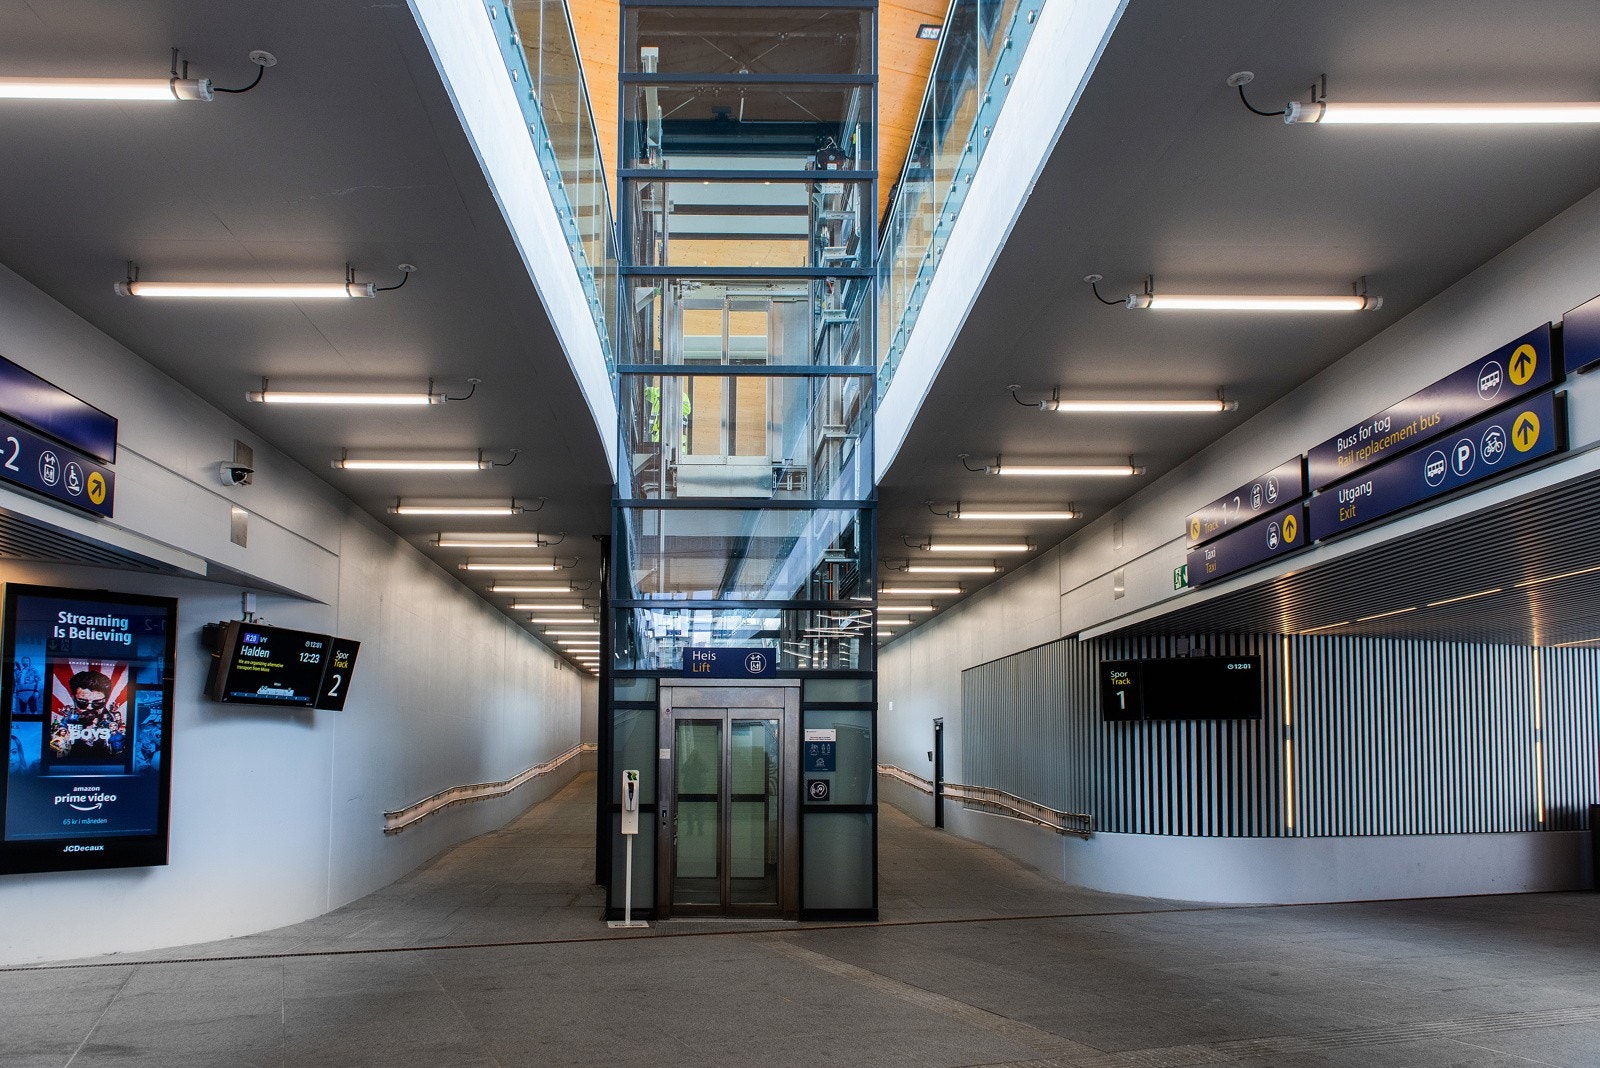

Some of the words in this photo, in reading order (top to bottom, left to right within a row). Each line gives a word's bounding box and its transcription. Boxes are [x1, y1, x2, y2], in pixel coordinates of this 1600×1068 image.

[1337, 433, 1357, 452] Buss
[1359, 424, 1373, 441] for
[1374, 415, 1391, 434] tog
[1337, 452, 1354, 469] Rail
[1355, 421, 1417, 462] replacement
[1420, 411, 1441, 431] bus
[1338, 480, 1373, 504] Utgang
[1339, 504, 1356, 522] Exit
[1204, 520, 1219, 534] Track
[1204, 546, 1216, 561] Taxi
[1205, 560, 1217, 574] Taxi
[58, 611, 129, 631] Streaming
[53, 625, 66, 638] Is
[69, 626, 132, 646] Believing
[245, 634, 257, 642] R20
[240, 645, 270, 658] Halden
[299, 652, 320, 664] 12:23
[335, 650, 349, 660] Spor
[692, 650, 717, 661] Heis
[333, 659, 348, 668] Track
[692, 662, 711, 673] Lift
[1110, 671, 1128, 679] Spor
[1111, 677, 1131, 685] Track
[328, 674, 342, 696] 2
[1116, 691, 1125, 710] 1
[67, 723, 83, 731] THE
[68, 728, 111, 743] BOYS
[54, 793, 86, 805] prime
[88, 792, 117, 802] video
[81, 817, 107, 825] måneden
[63, 844, 104, 853] JCDecaux
